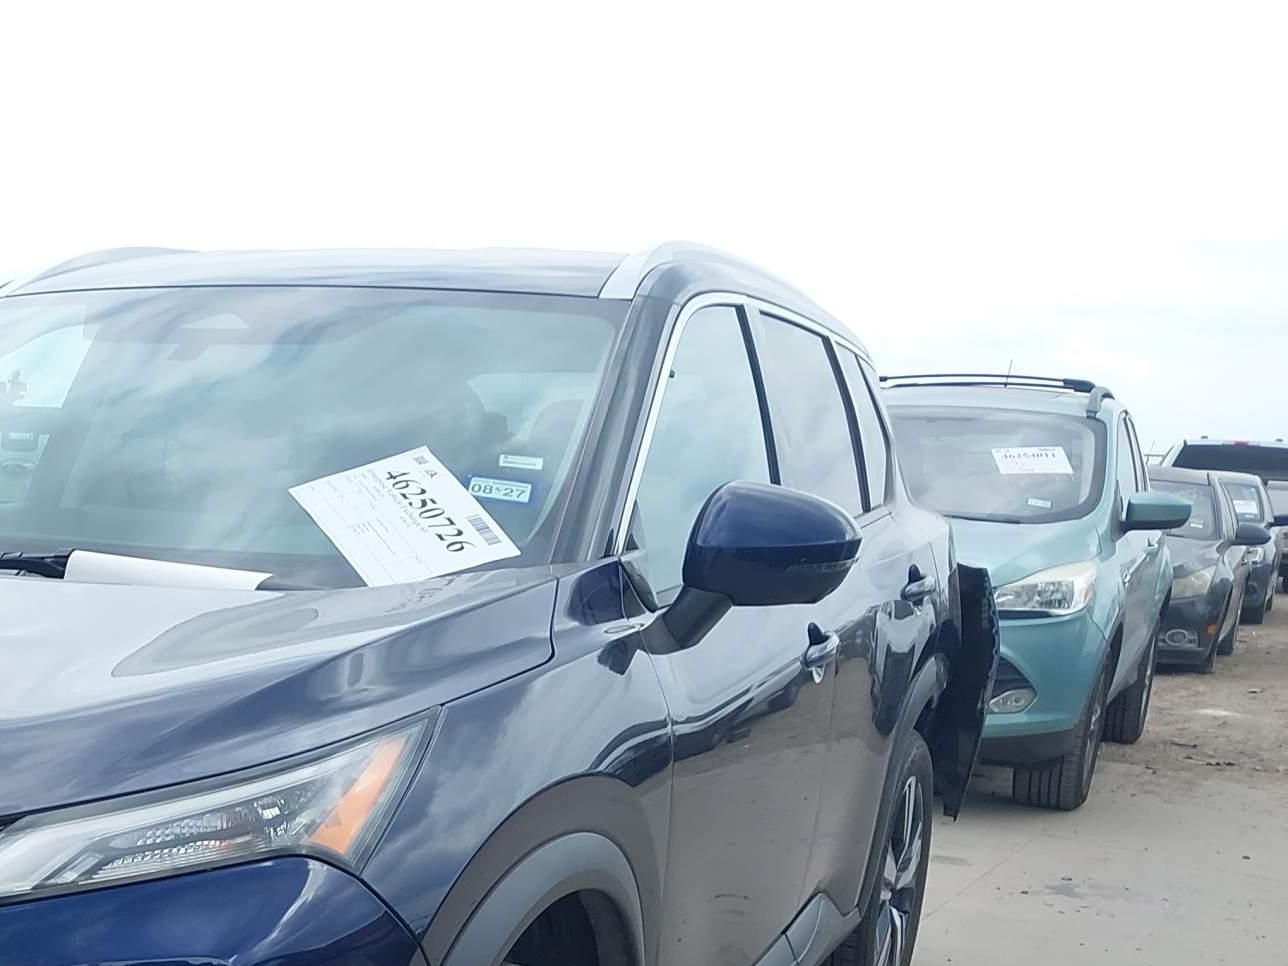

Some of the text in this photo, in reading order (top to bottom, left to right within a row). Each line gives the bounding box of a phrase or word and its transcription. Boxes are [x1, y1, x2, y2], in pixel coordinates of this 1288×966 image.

[386, 471, 477, 552] 46250726
[471, 483, 493, 494] 08
[502, 487, 526, 498] 27
